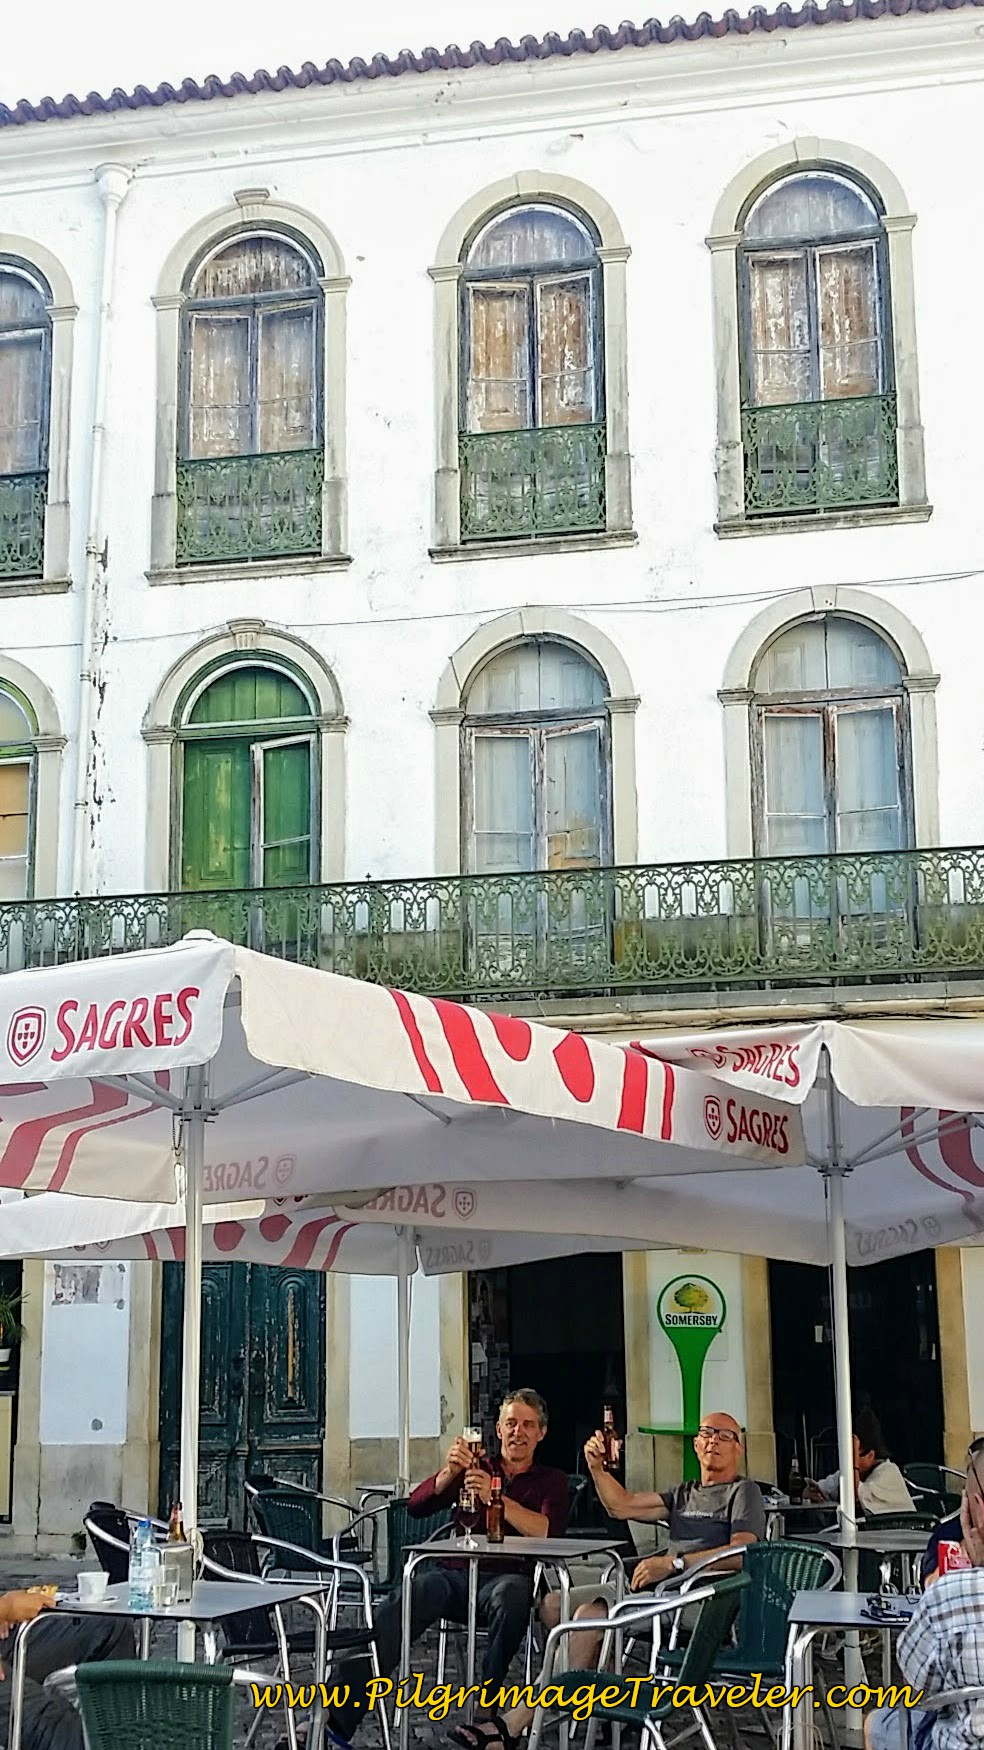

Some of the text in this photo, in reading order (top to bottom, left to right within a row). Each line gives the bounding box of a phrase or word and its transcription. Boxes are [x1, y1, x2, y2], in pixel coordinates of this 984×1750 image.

[50, 986, 201, 1062] SAGRES
[726, 1042, 801, 1088] SAGRES
[726, 1099, 790, 1155] SAGRES
[665, 1313, 718, 1326] SOMERSBY
